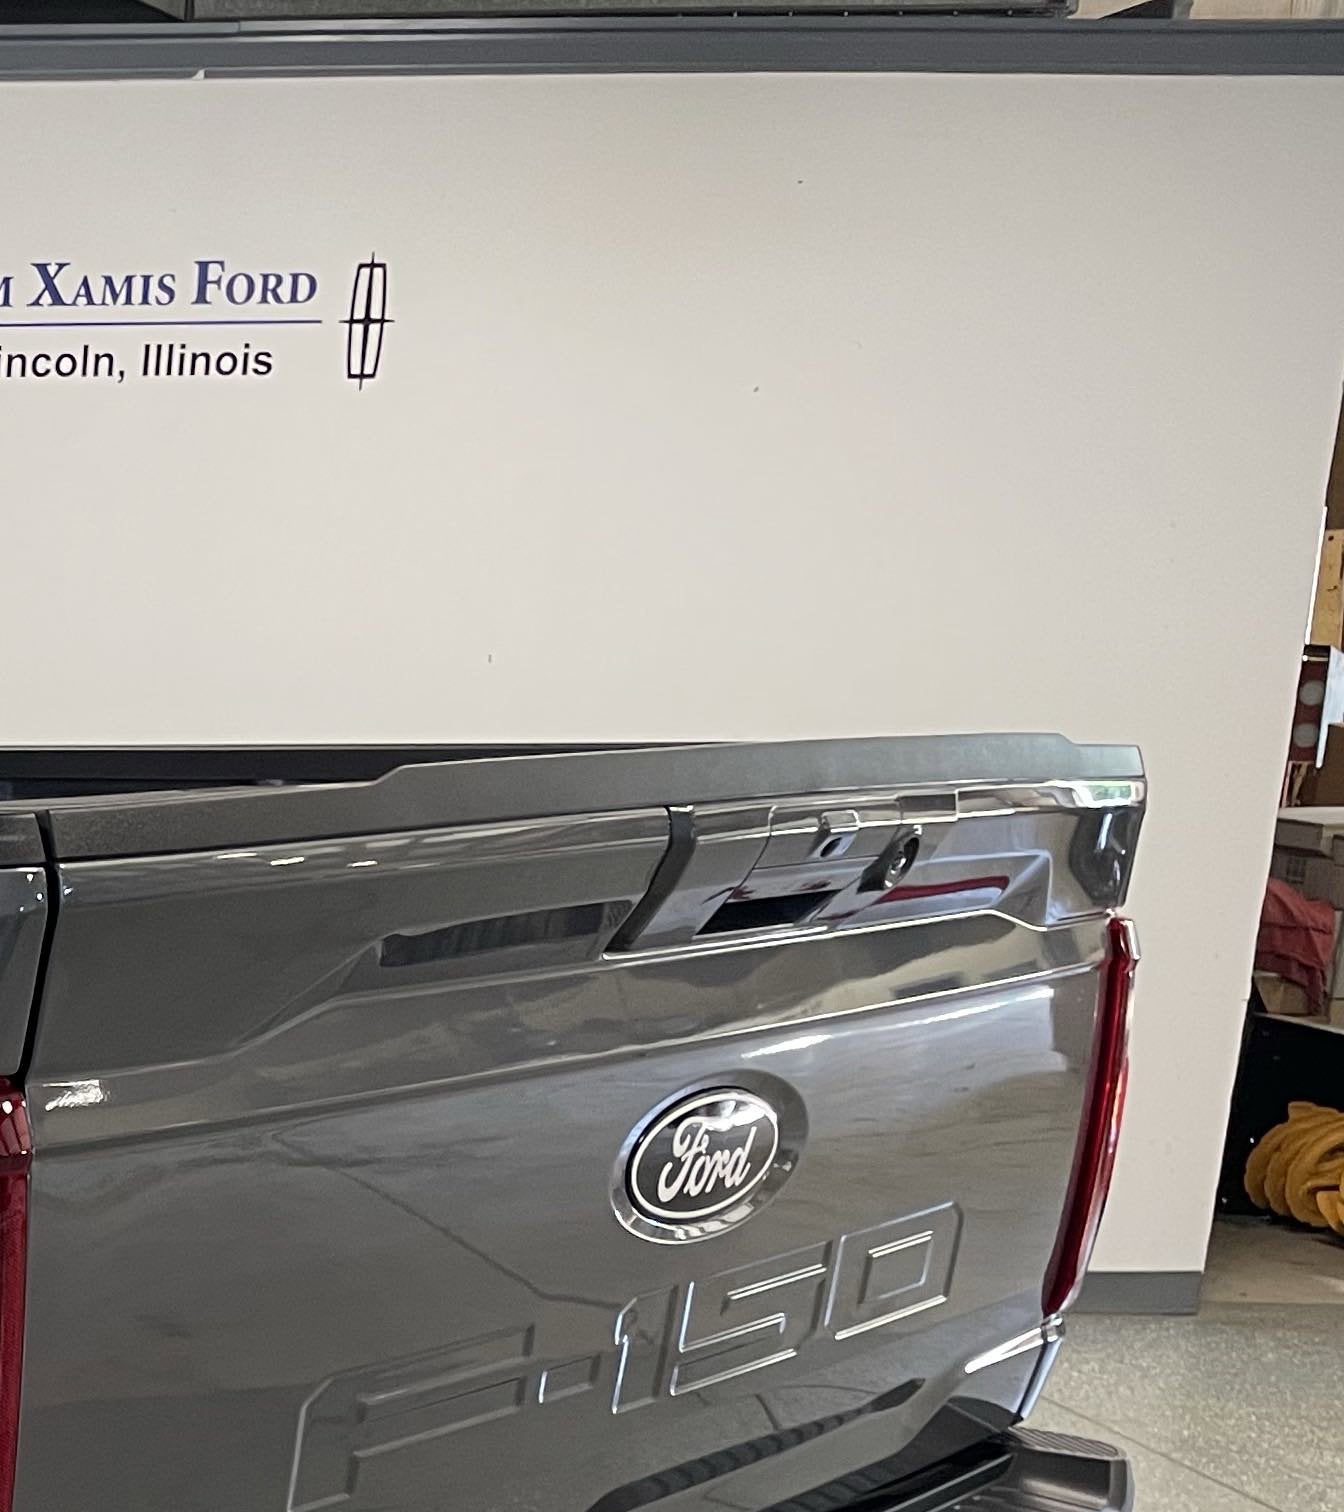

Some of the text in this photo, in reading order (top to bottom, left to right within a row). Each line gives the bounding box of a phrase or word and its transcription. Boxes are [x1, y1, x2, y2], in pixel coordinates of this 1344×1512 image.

[26, 260, 177, 308] XAMIS
[193, 259, 318, 307] FORD
[142, 342, 274, 377] Illinois
[657, 1114, 757, 1203] Ford
